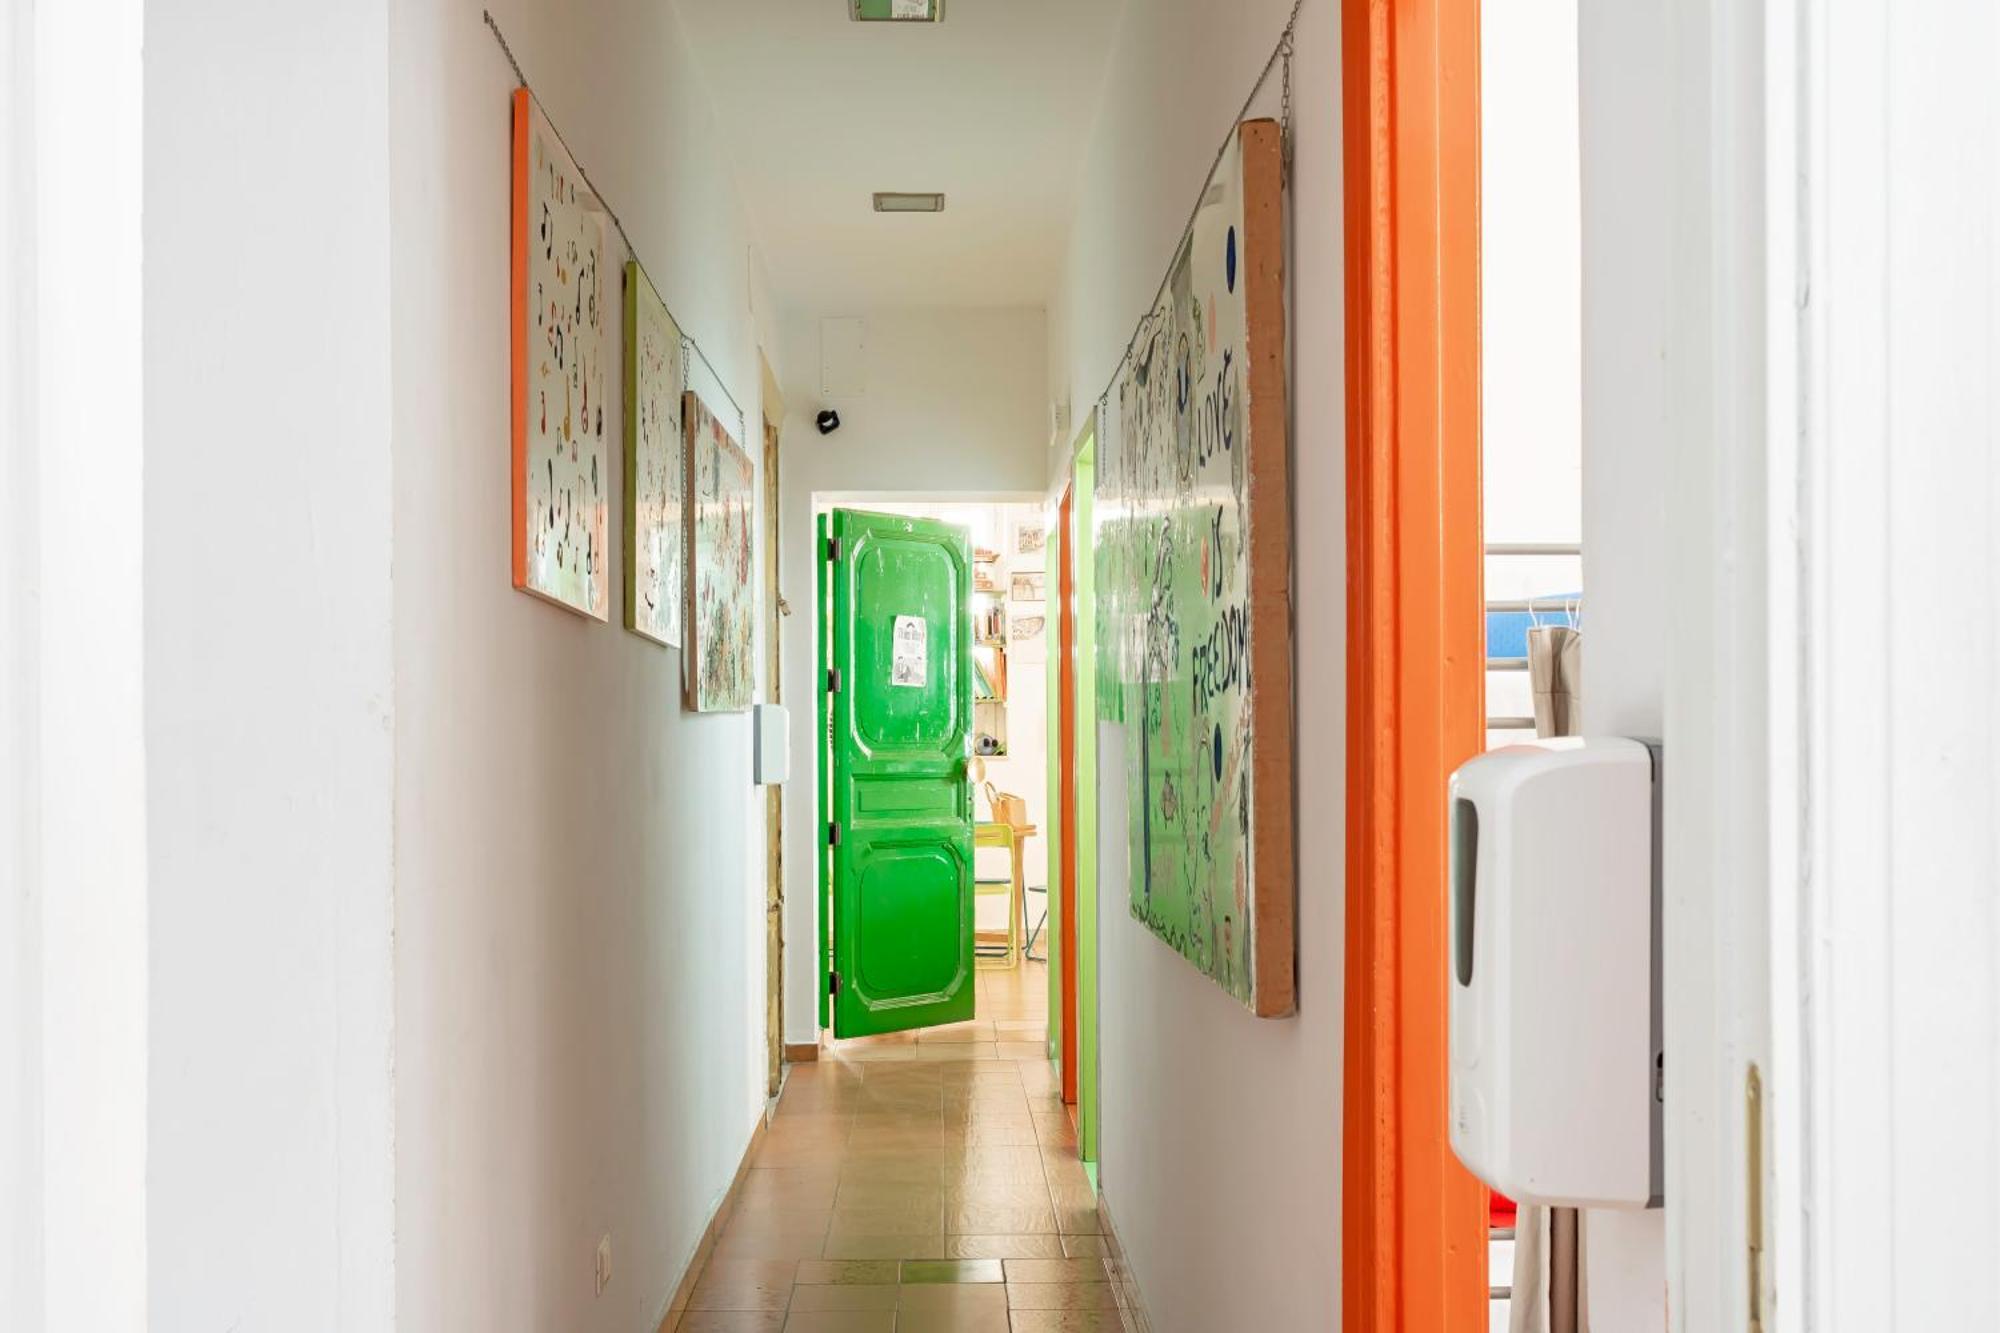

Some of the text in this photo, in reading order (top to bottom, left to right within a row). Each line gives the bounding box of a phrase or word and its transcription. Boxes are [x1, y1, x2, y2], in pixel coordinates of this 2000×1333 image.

[1198, 346, 1232, 468] LOVE
[1211, 504, 1223, 606] IS
[1193, 598, 1251, 716] FREEDOM
